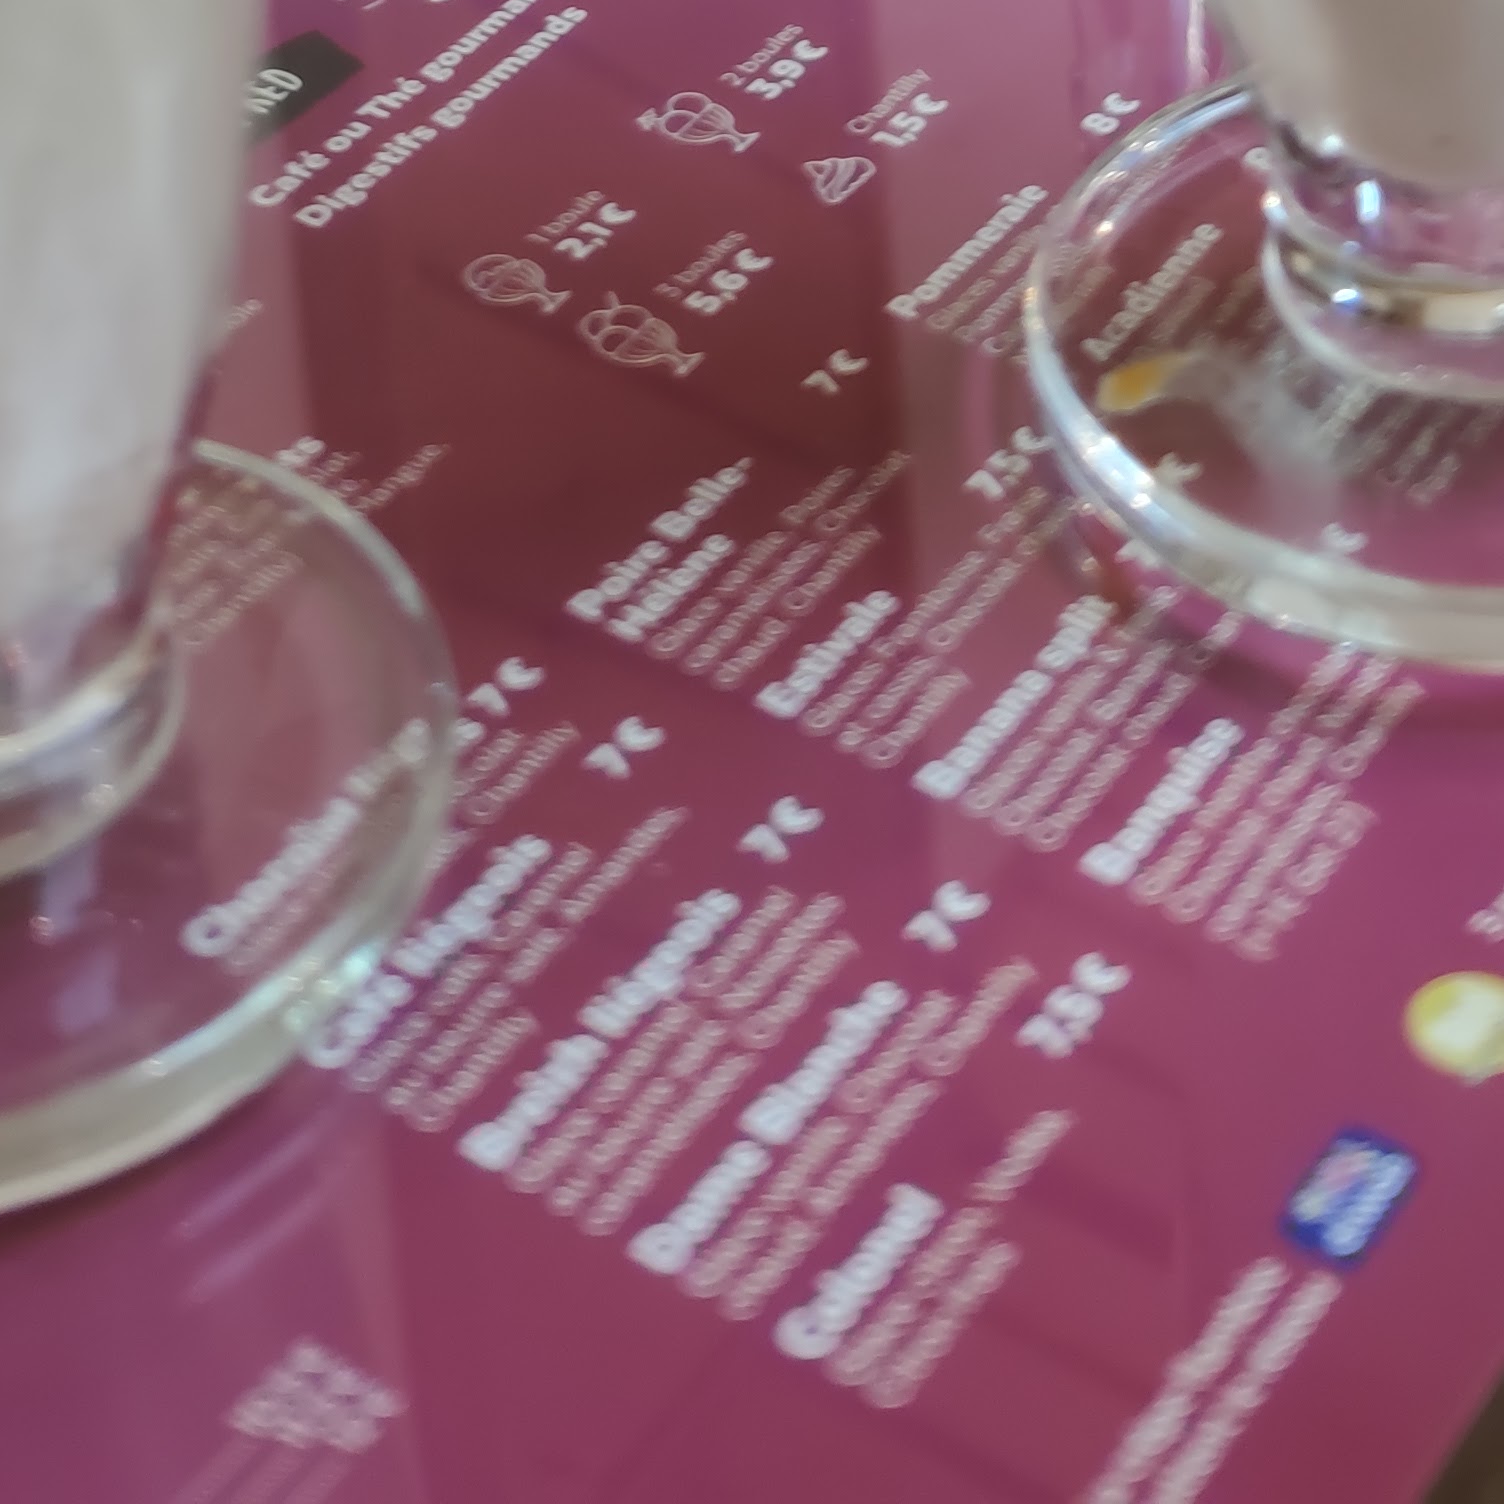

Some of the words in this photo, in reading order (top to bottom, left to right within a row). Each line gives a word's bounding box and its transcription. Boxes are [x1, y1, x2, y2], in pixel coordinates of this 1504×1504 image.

[737, 23, 804, 75] boules
[249, 148, 330, 207] Café
[323, 120, 371, 153] ou
[356, 76, 427, 121] Thé
[293, 124, 438, 227] Digestifs
[430, 5, 588, 131] gourmands
[1081, 91, 1141, 135] 8€
[542, 189, 605, 234] boule
[565, 539, 672, 622] Poire
